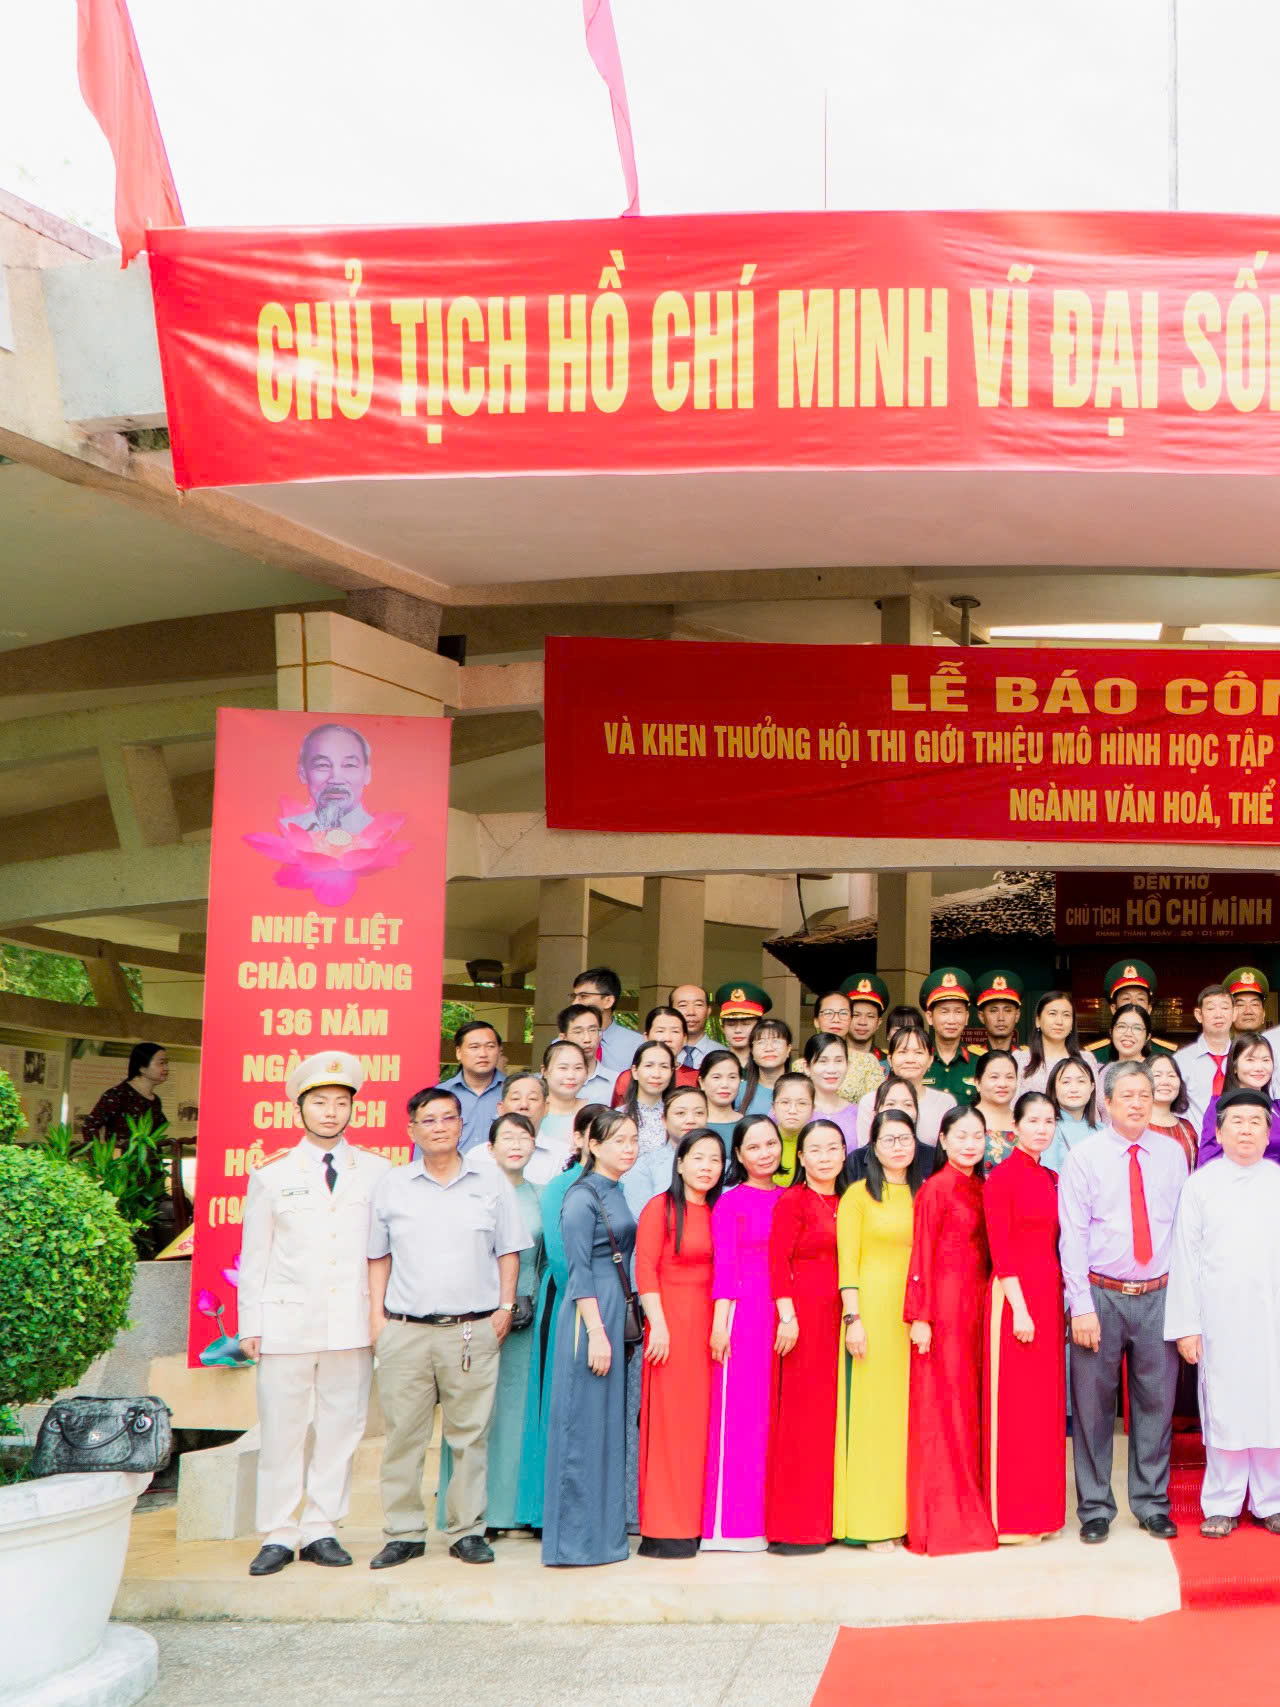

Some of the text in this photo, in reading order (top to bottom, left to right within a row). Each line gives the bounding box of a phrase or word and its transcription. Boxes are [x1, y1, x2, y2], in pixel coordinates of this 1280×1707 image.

[256, 259, 374, 422] CHỦ
[391, 296, 526, 443] TỊCH
[548, 250, 629, 413] HỒ
[652, 264, 757, 410] CHÍ
[778, 287, 948, 408] MINH
[970, 264, 1034, 408] VĨ
[1050, 289, 1159, 436] ĐẠI
[891, 661, 968, 713] LỄ
[996, 669, 1137, 714] BÁO
[604, 716, 635, 755] VÀ
[642, 722, 705, 757] KHEN
[714, 716, 810, 760] THƯỞNG
[819, 722, 859, 768] HỘI
[867, 729, 906, 762] THI
[915, 725, 964, 763] GIỚI
[975, 725, 1043, 771] THIỆU
[1052, 726, 1092, 765] MÔ
[1101, 728, 1160, 766] HÌNH
[1169, 733, 1218, 774] HỌC
[1227, 728, 1273, 774] TẬP
[1010, 782, 1096, 822] NGÀNH
[1105, 784, 1155, 823] VĂN
[1164, 785, 1221, 829] HOÁ,
[1229, 779, 1277, 825] THỂ
[251, 912, 403, 950] NHIỆT LIỆT
[238, 957, 412, 991] CHÀO MỪNG
[259, 1003, 388, 1036] 136 NĂM
[242, 1049, 304, 1082] NGÀ
